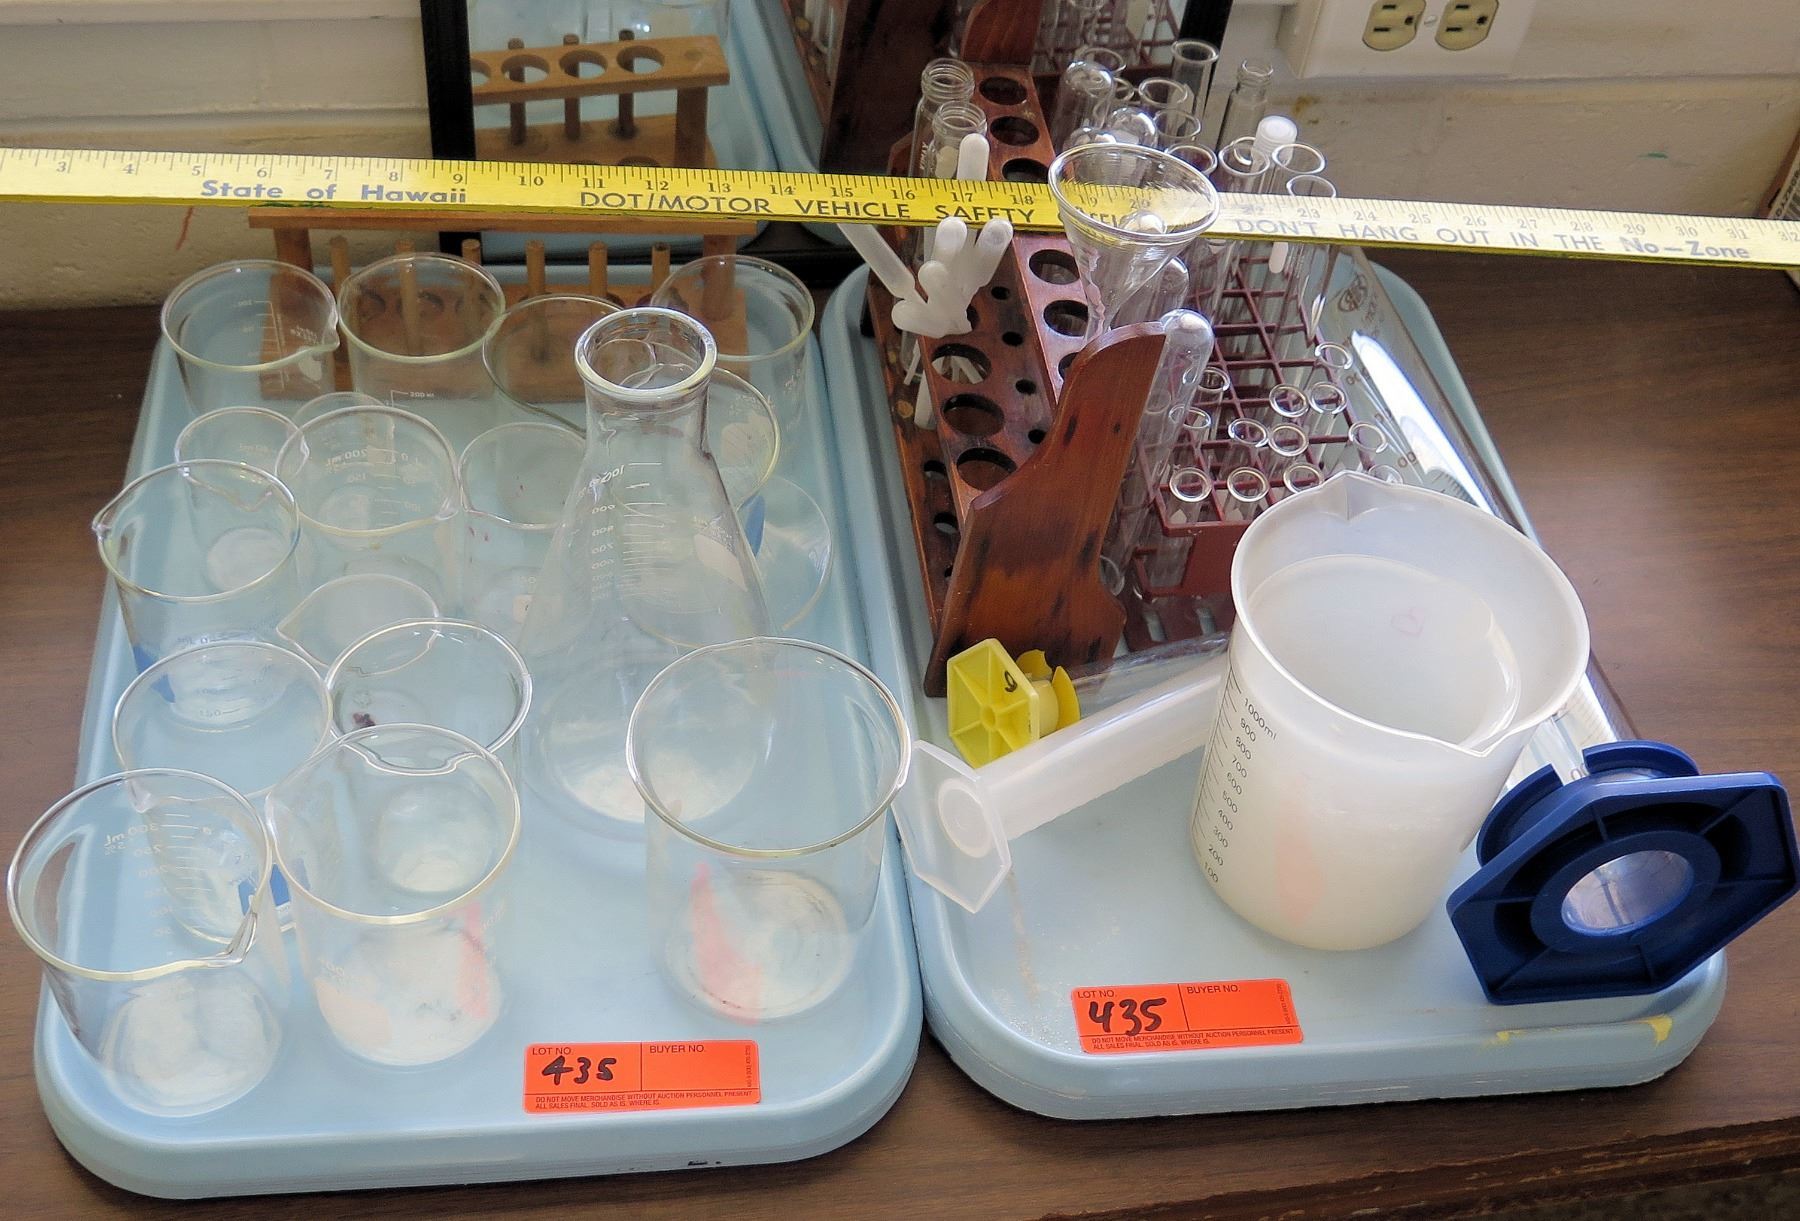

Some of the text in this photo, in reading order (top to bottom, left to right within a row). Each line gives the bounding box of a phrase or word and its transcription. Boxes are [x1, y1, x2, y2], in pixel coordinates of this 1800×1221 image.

[55, 160, 67, 173] 3
[122, 162, 134, 175] 4
[191, 164, 201, 177] 5
[256, 166, 268, 179] 6
[323, 168, 334, 180] 7
[388, 170, 399, 182] 8
[452, 173, 464, 185] 9
[518, 174, 544, 187] 10
[582, 176, 604, 189] 11
[646, 178, 669, 191] 12
[708, 181, 731, 194] 13
[770, 184, 794, 196] 14
[831, 186, 853, 198] 15
[891, 188, 915, 201] 16
[952, 191, 973, 203] 17
[1013, 193, 1034, 206] 18
[1299, 207, 1321, 219] 23
[1353, 210, 1377, 222] 24
[1408, 213, 1432, 225] 25
[1463, 215, 1487, 227] 26
[1517, 218, 1538, 230] 27
[1570, 220, 1593, 233] 28
[1623, 223, 1646, 235] 29
[1676, 225, 1698, 238] 30
[202, 179, 283, 199] State
[306, 183, 337, 200] of
[361, 183, 466, 204] Hawaii
[580, 191, 774, 215] DOT/MOTOR
[794, 199, 911, 219] VEHICLE
[936, 203, 1035, 224] SAFETY
[1338, 223, 1421, 242] HANG
[1435, 227, 1493, 246] OUT
[1509, 231, 1540, 248] IN
[1553, 233, 1606, 251] THE
[1240, 717, 1257, 743] 900
[1243, 697, 1278, 741] 1000ml
[1235, 736, 1252, 760] 800
[1231, 755, 1248, 779] 700
[1226, 772, 1243, 796] 600
[1222, 790, 1238, 814] 500
[1212, 825, 1229, 848] 300
[1207, 844, 1224, 867] 200
[1078, 990, 1098, 999] LOT
[1186, 984, 1241, 995] BUYER NO.
[1088, 997, 1167, 1036] 435
[532, 1047, 552, 1056] LOT
[650, 1045, 685, 1054] BUYER
[541, 1055, 617, 1086] 435
